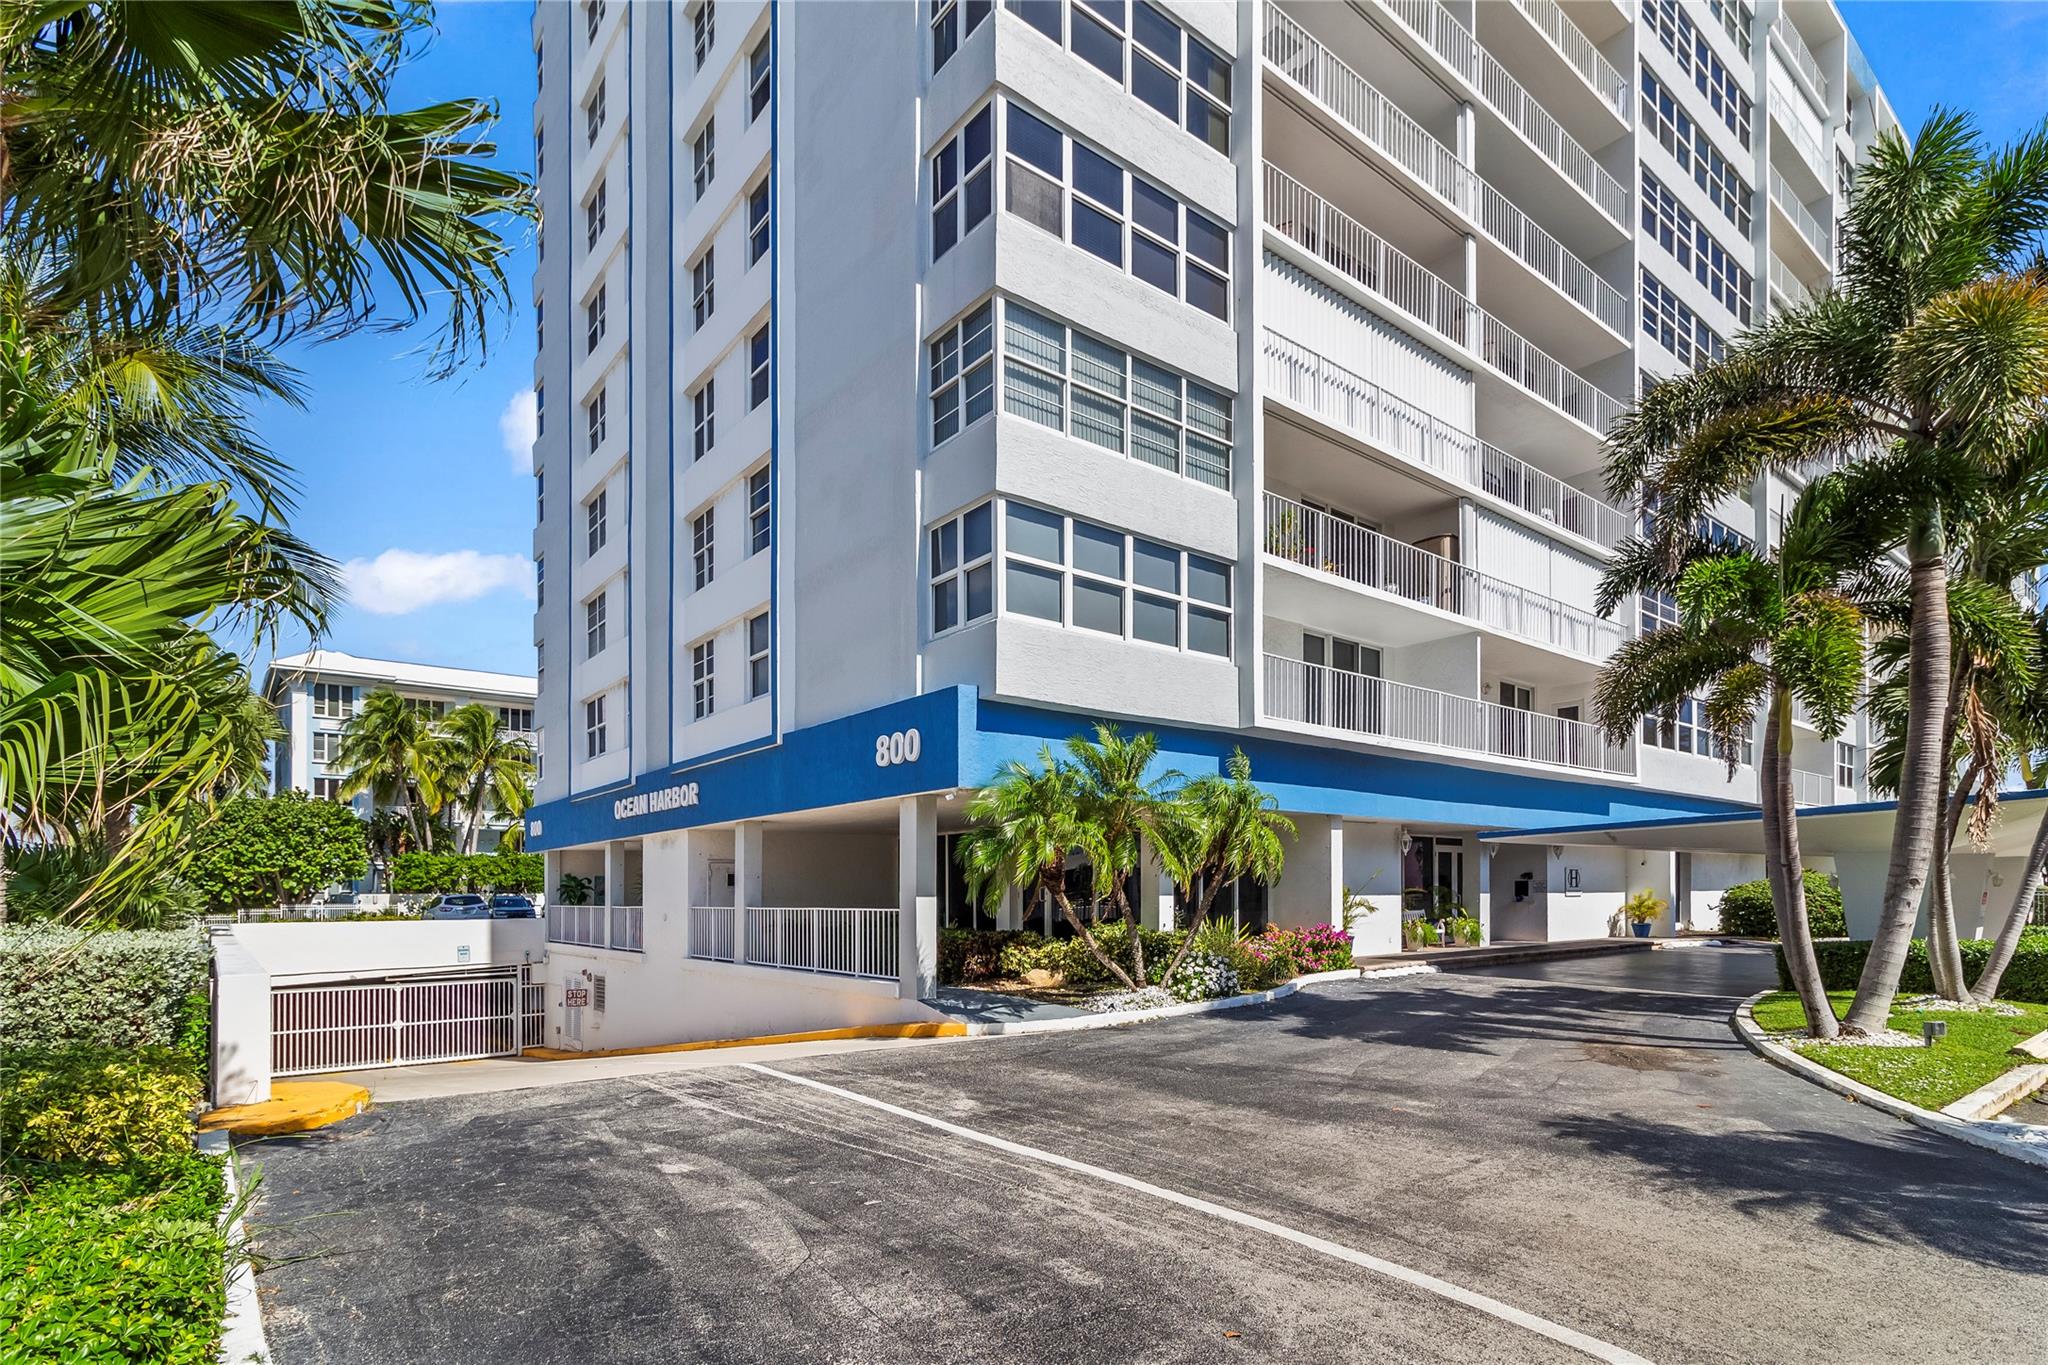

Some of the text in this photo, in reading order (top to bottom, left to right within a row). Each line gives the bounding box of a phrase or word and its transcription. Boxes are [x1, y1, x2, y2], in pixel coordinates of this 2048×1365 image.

[876, 728, 921, 767] 800
[614, 782, 699, 820] OCEAN HARBOR
[567, 990, 587, 998] STOP
[567, 998, 587, 1006] HERE
